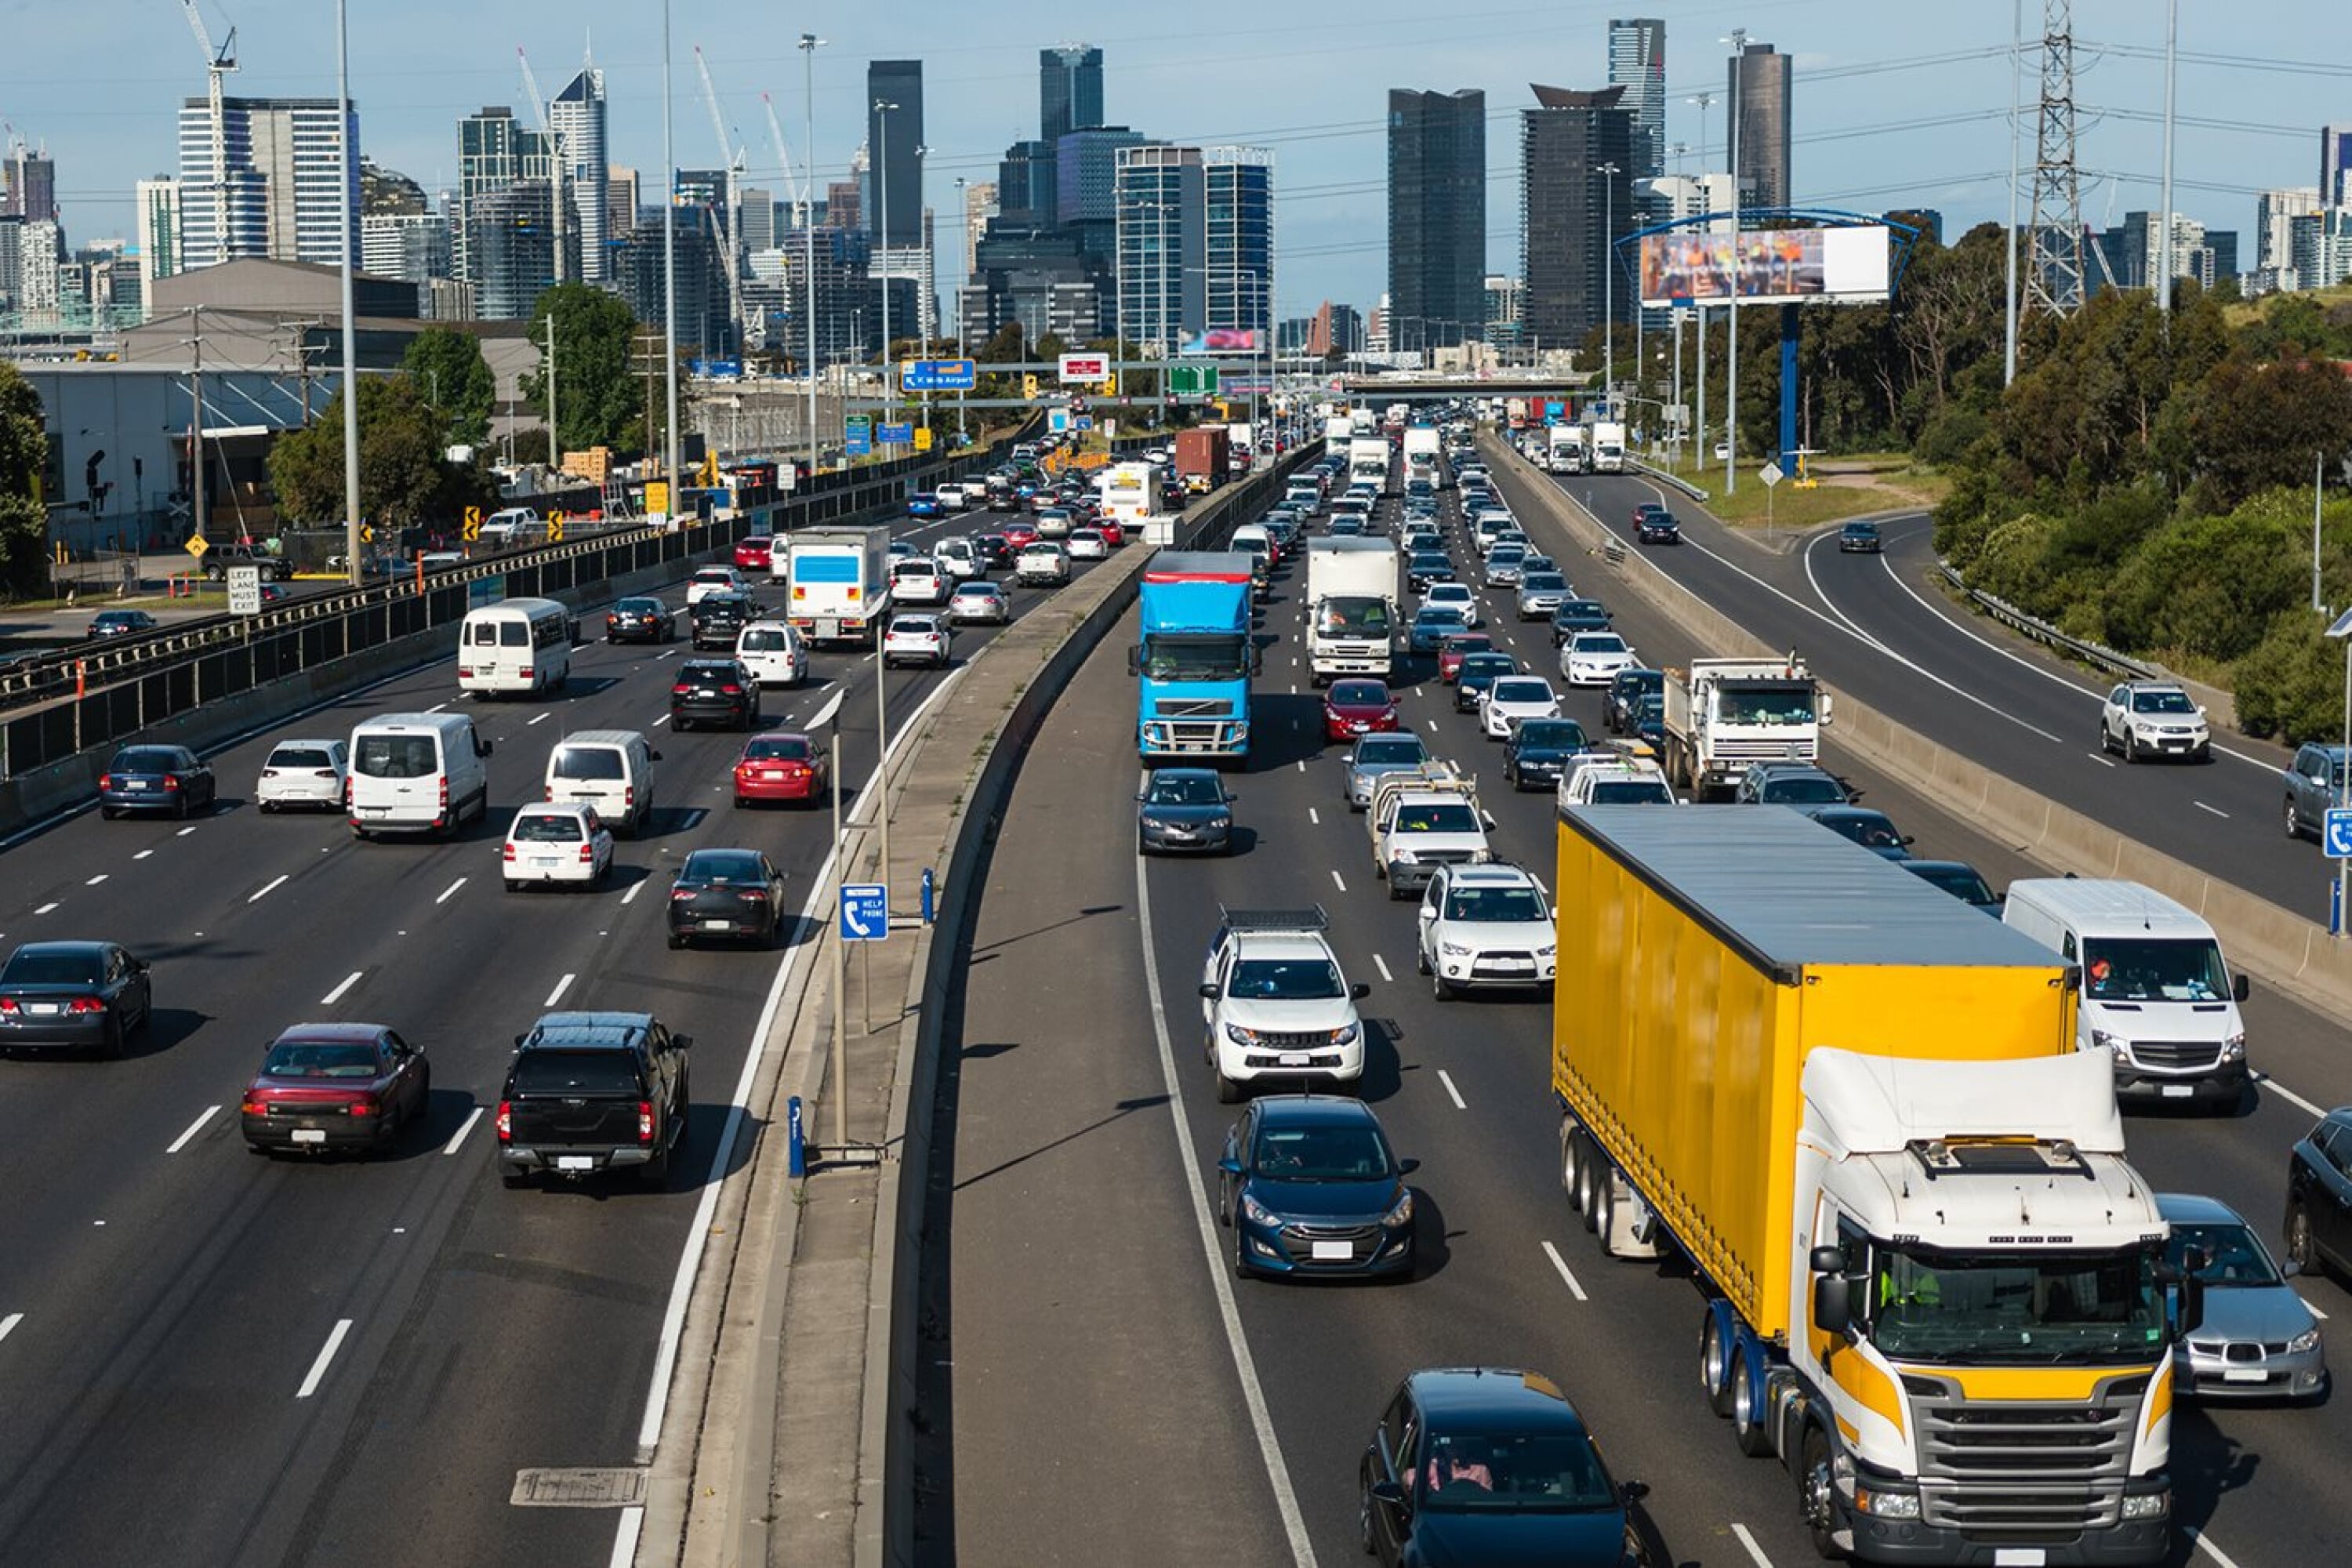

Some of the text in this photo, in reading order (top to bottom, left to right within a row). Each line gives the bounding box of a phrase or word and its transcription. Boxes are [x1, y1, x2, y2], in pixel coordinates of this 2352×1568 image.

[231, 570, 254, 579] LEFT
[862, 899, 884, 909] HELP
[862, 909, 884, 917] PHONE
